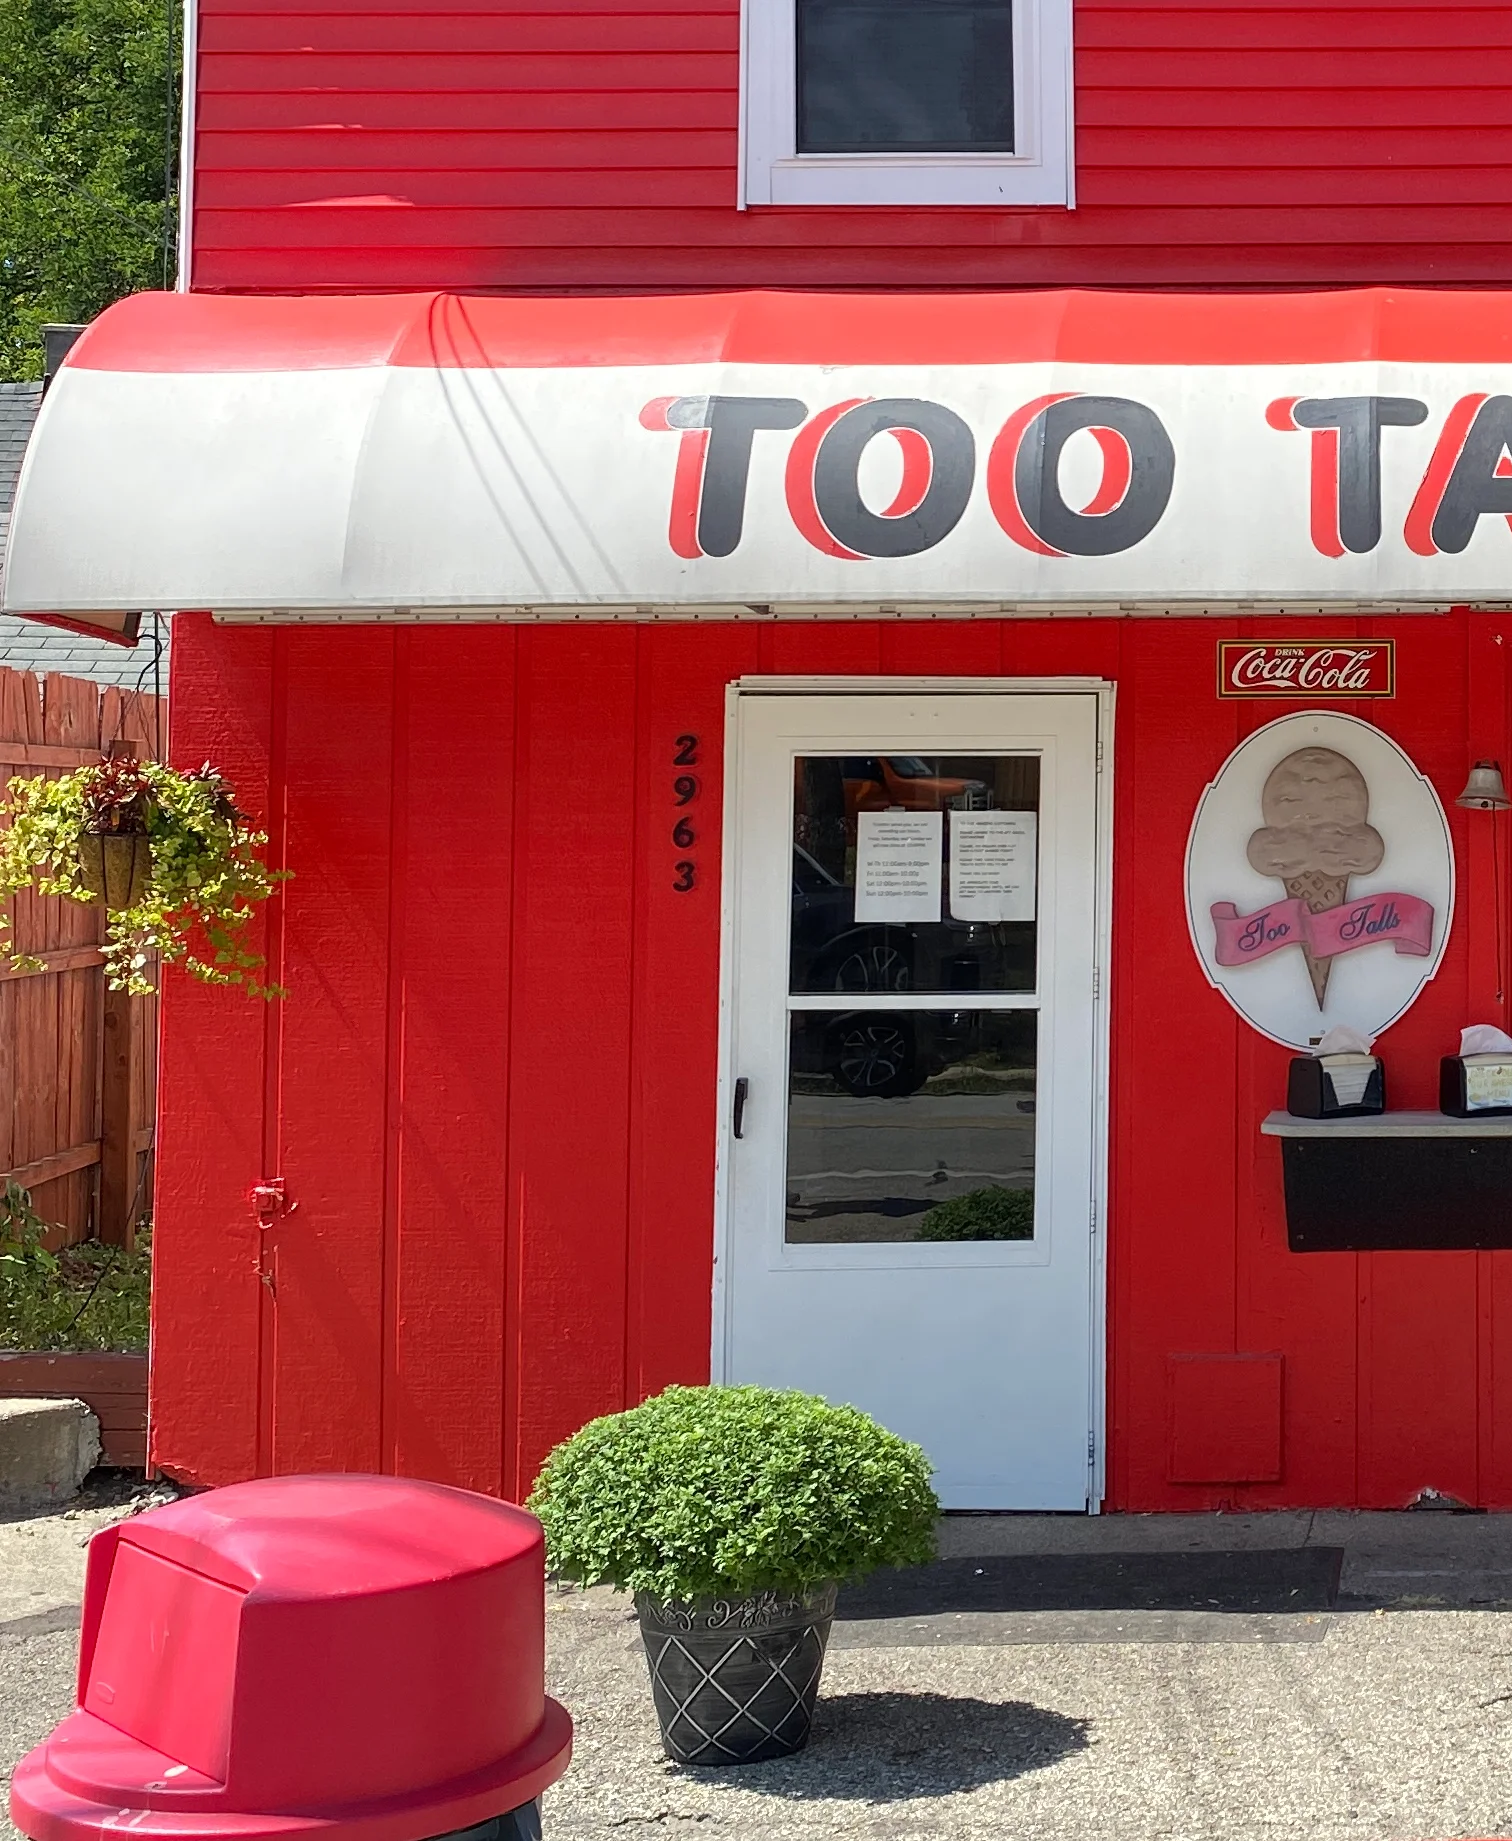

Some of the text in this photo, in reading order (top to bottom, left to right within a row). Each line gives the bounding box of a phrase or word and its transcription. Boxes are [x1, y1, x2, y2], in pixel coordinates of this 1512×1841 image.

[638, 392, 1175, 560] TOO
[1231, 648, 1377, 689] Coca-Cola
[1274, 649, 1305, 657] DRINK
[1238, 902, 1401, 952] Too Talls
